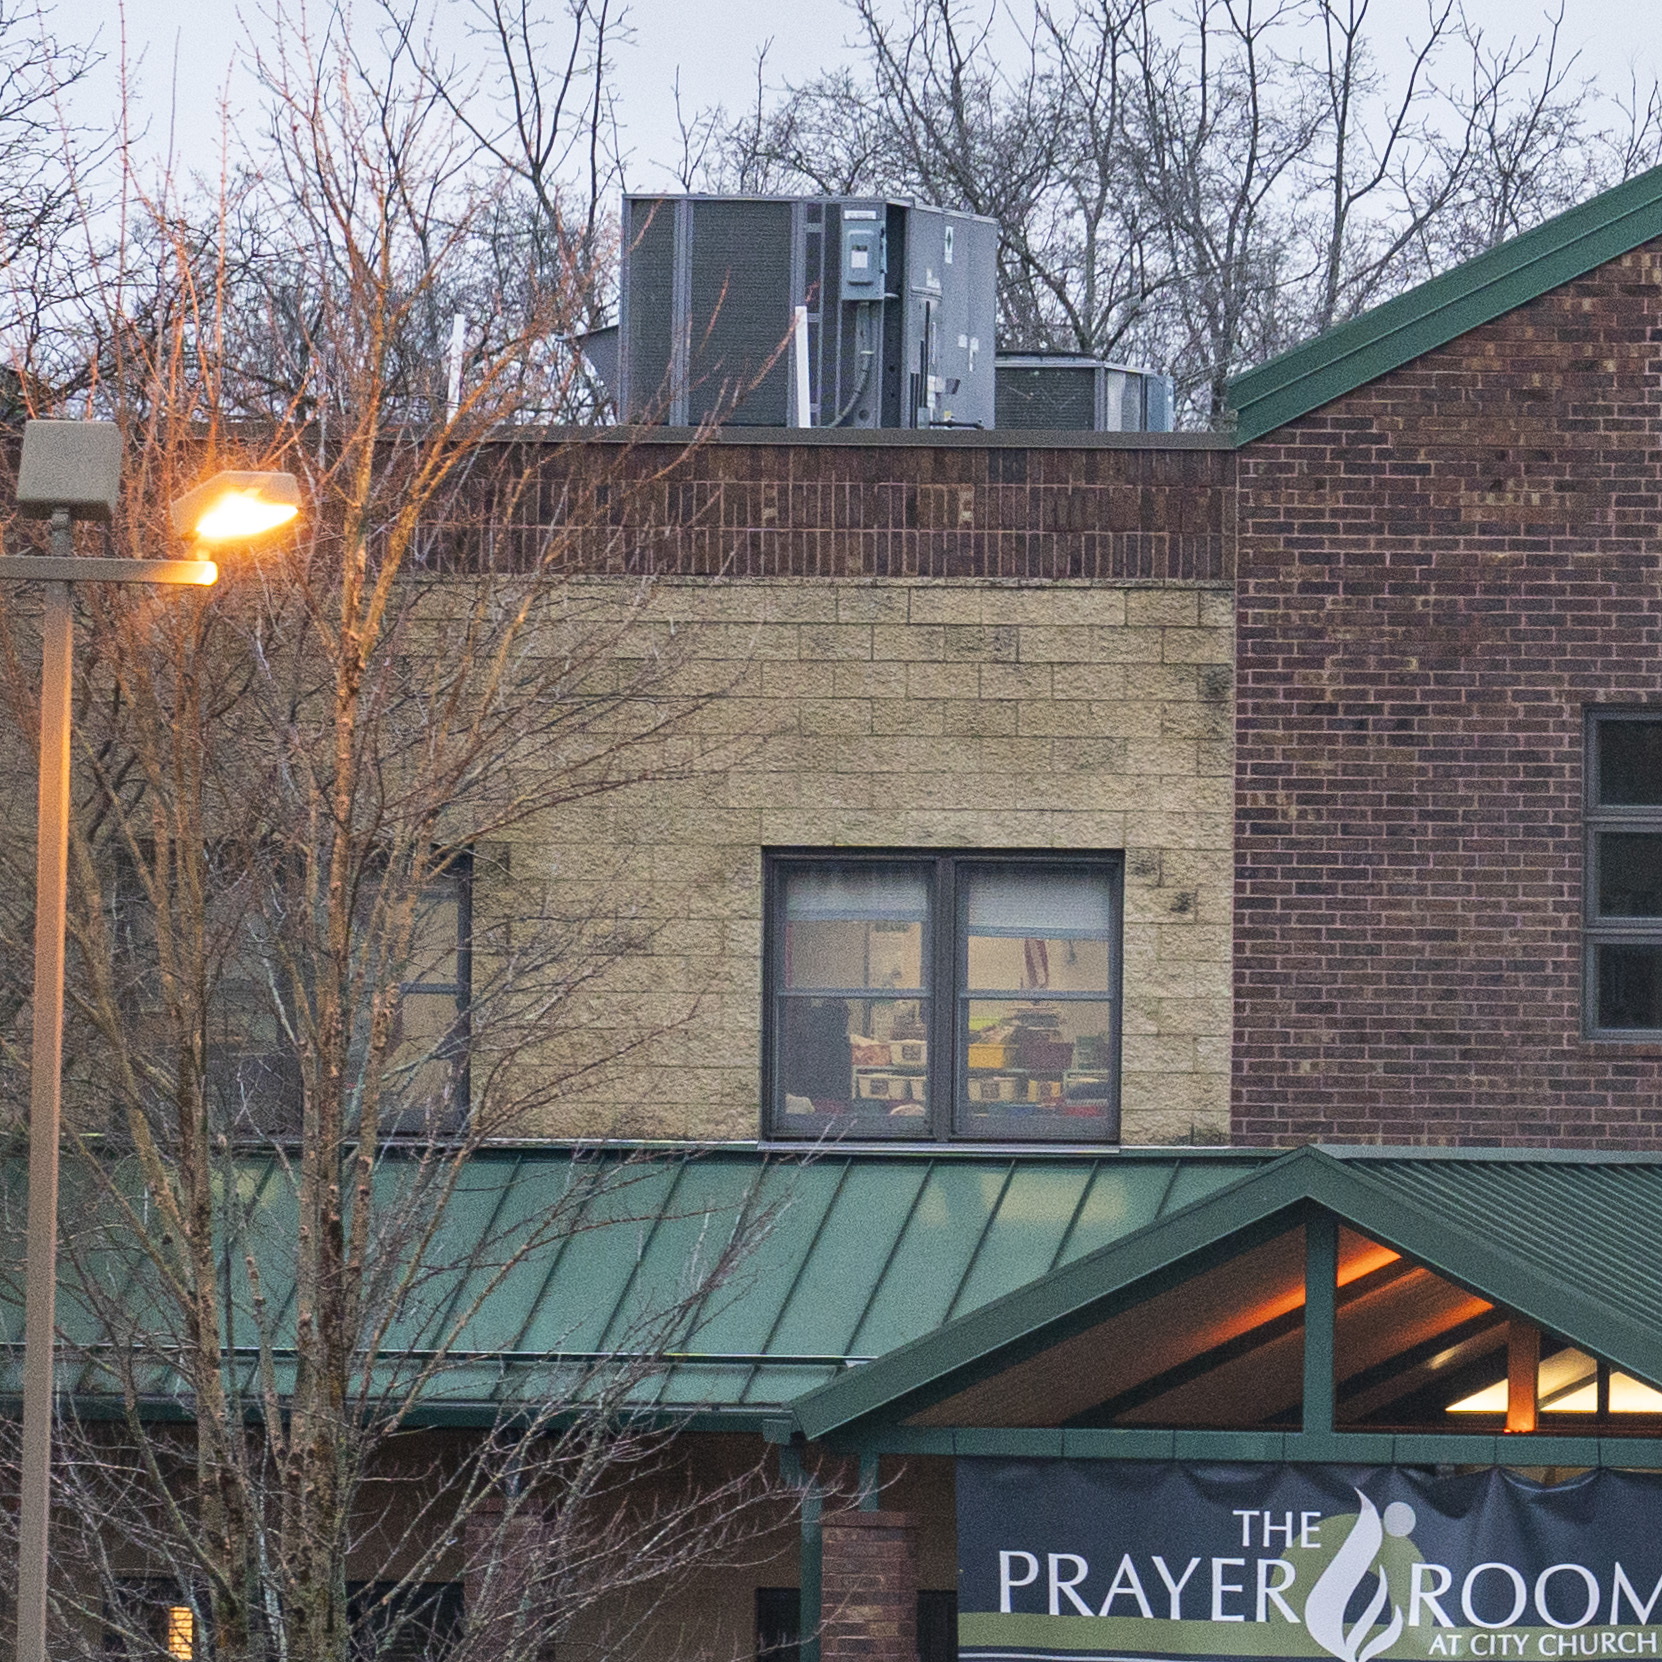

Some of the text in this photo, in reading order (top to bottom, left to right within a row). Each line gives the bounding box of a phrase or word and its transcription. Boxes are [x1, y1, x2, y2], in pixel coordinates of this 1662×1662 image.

[1232, 1509, 1322, 1548] THE
[999, 1550, 1301, 1623] PRAYER
[1428, 1631, 1658, 1657] AT CITY CHURCH
